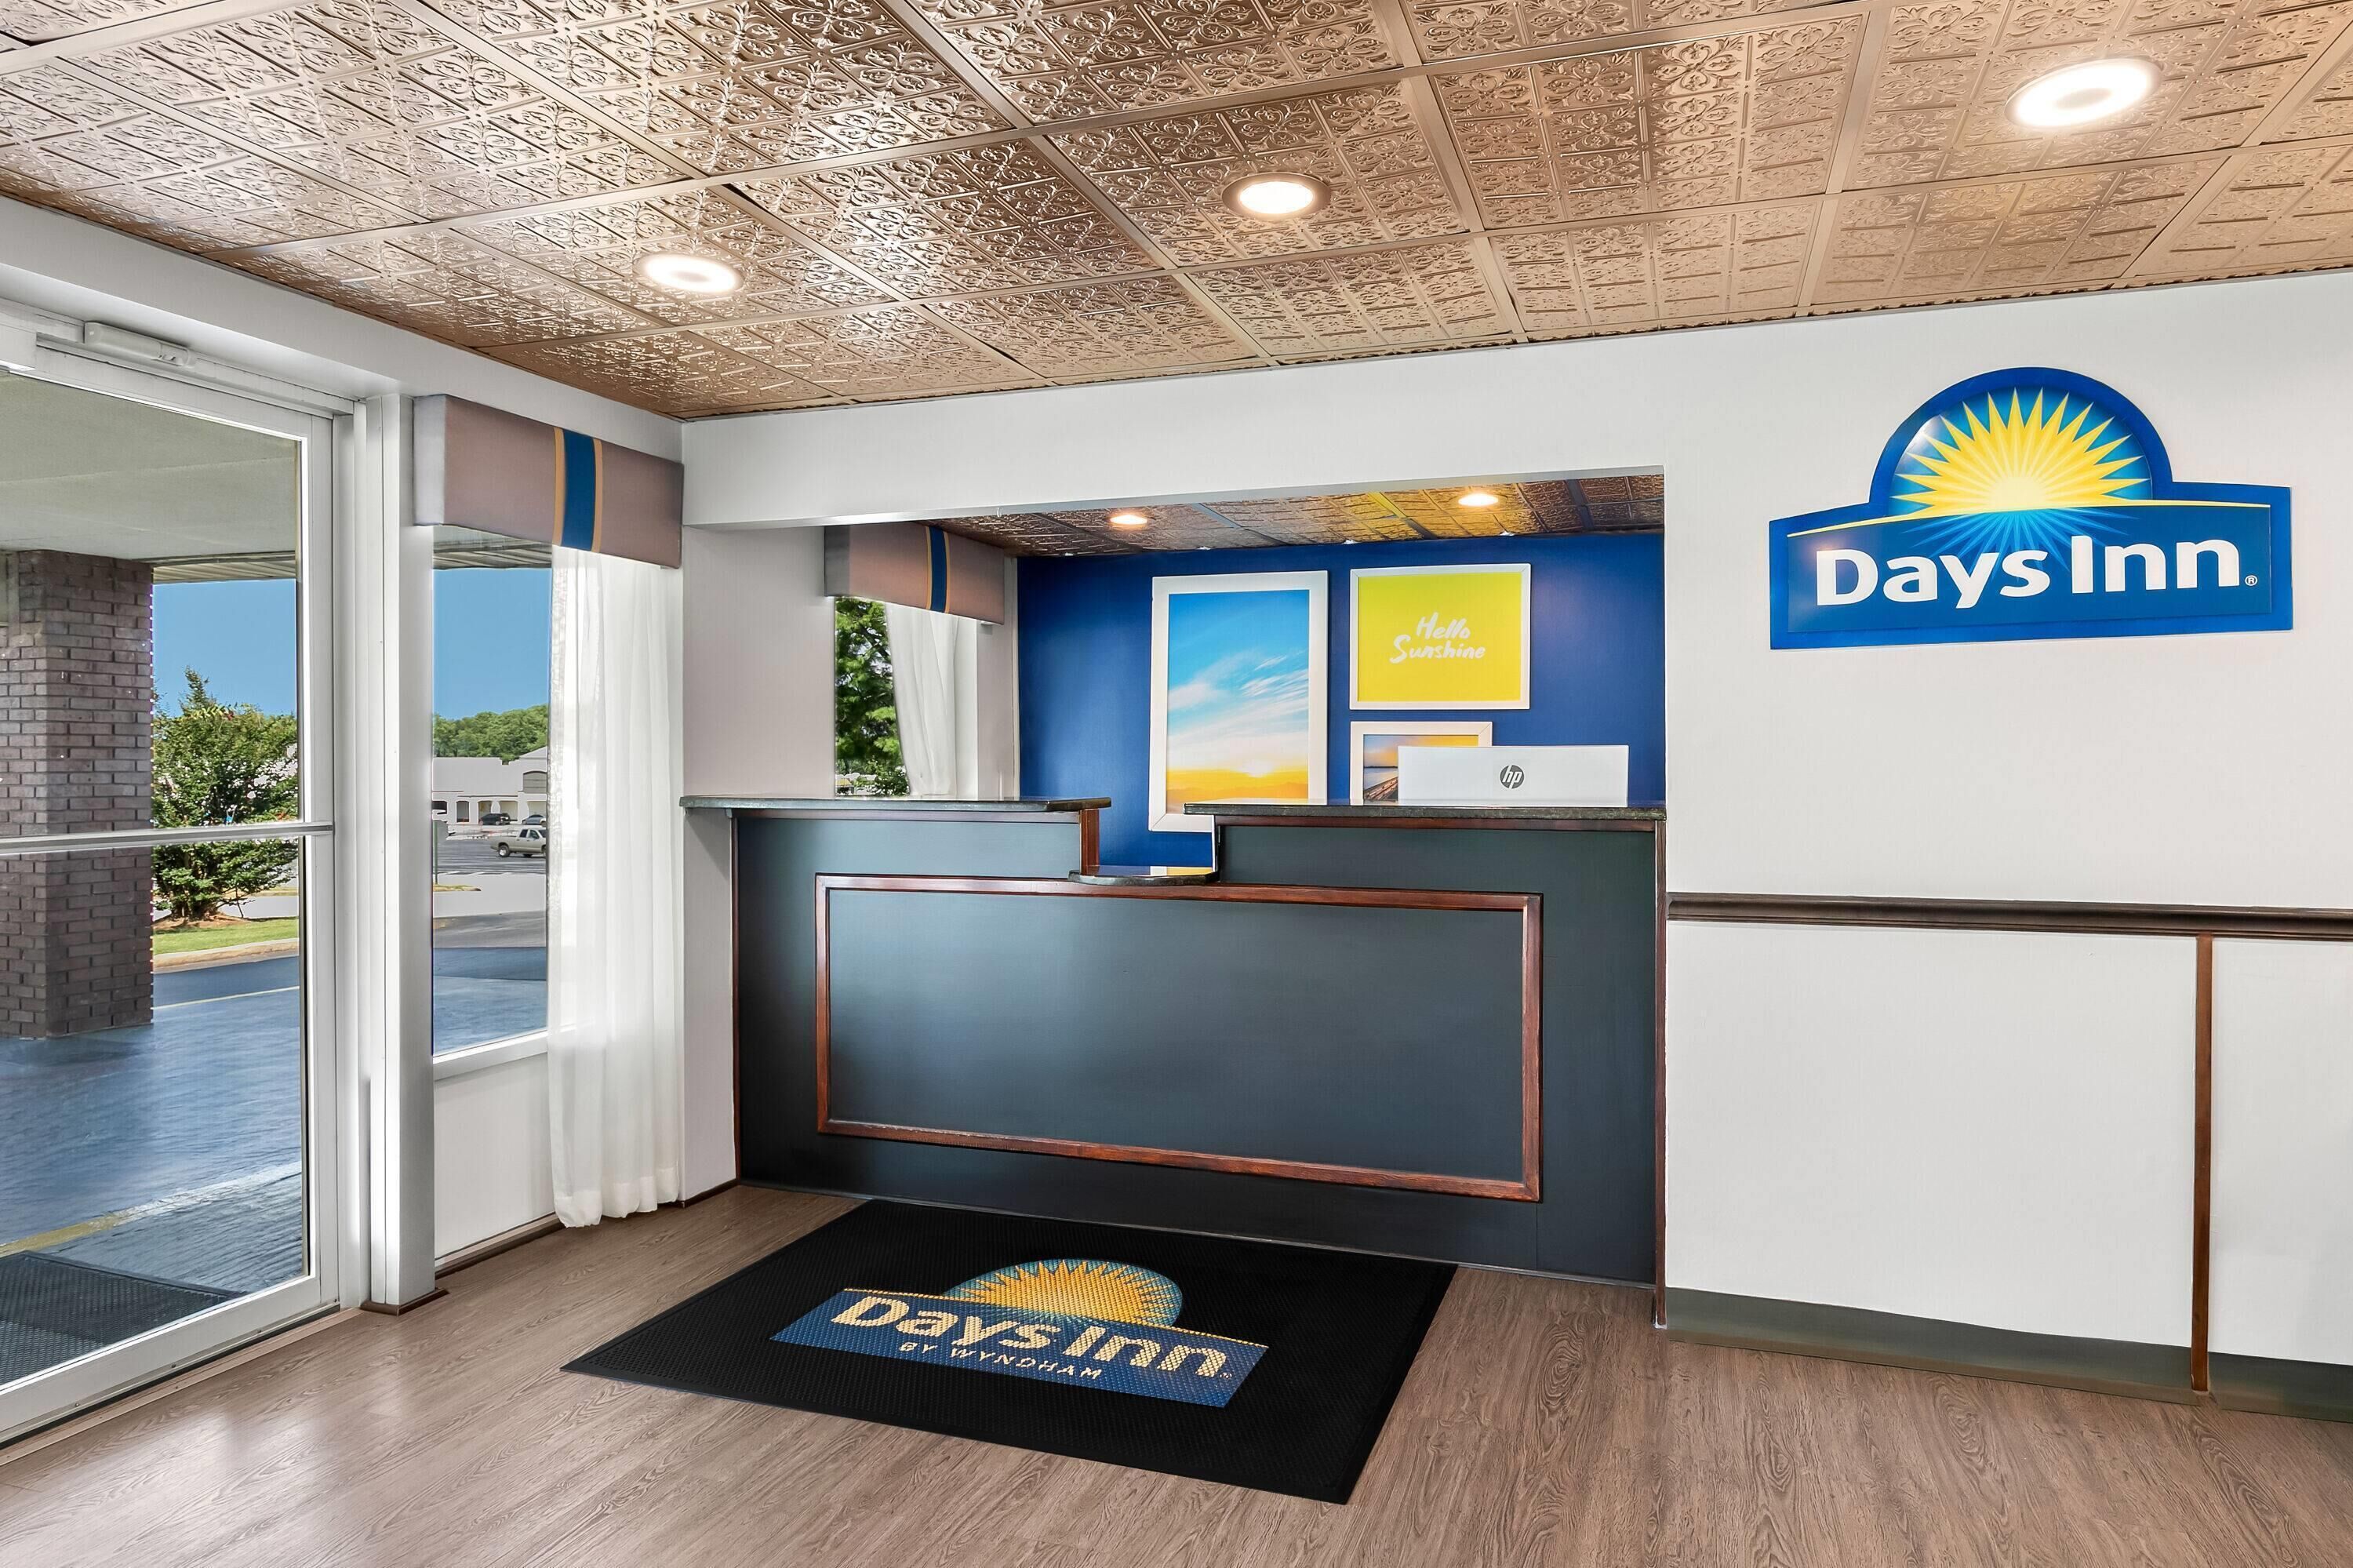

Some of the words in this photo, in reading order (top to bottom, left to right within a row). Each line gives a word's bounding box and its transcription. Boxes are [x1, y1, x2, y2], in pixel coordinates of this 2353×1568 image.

[1816, 548, 2050, 609] Days
[1417, 612, 1471, 640] Hello
[1390, 635, 1486, 664] Sunshine
[1501, 765, 1523, 789] hp
[831, 1296, 1061, 1348] Days
[899, 1342, 938, 1353] BY
[951, 1348, 1101, 1379] WYNDHAM
